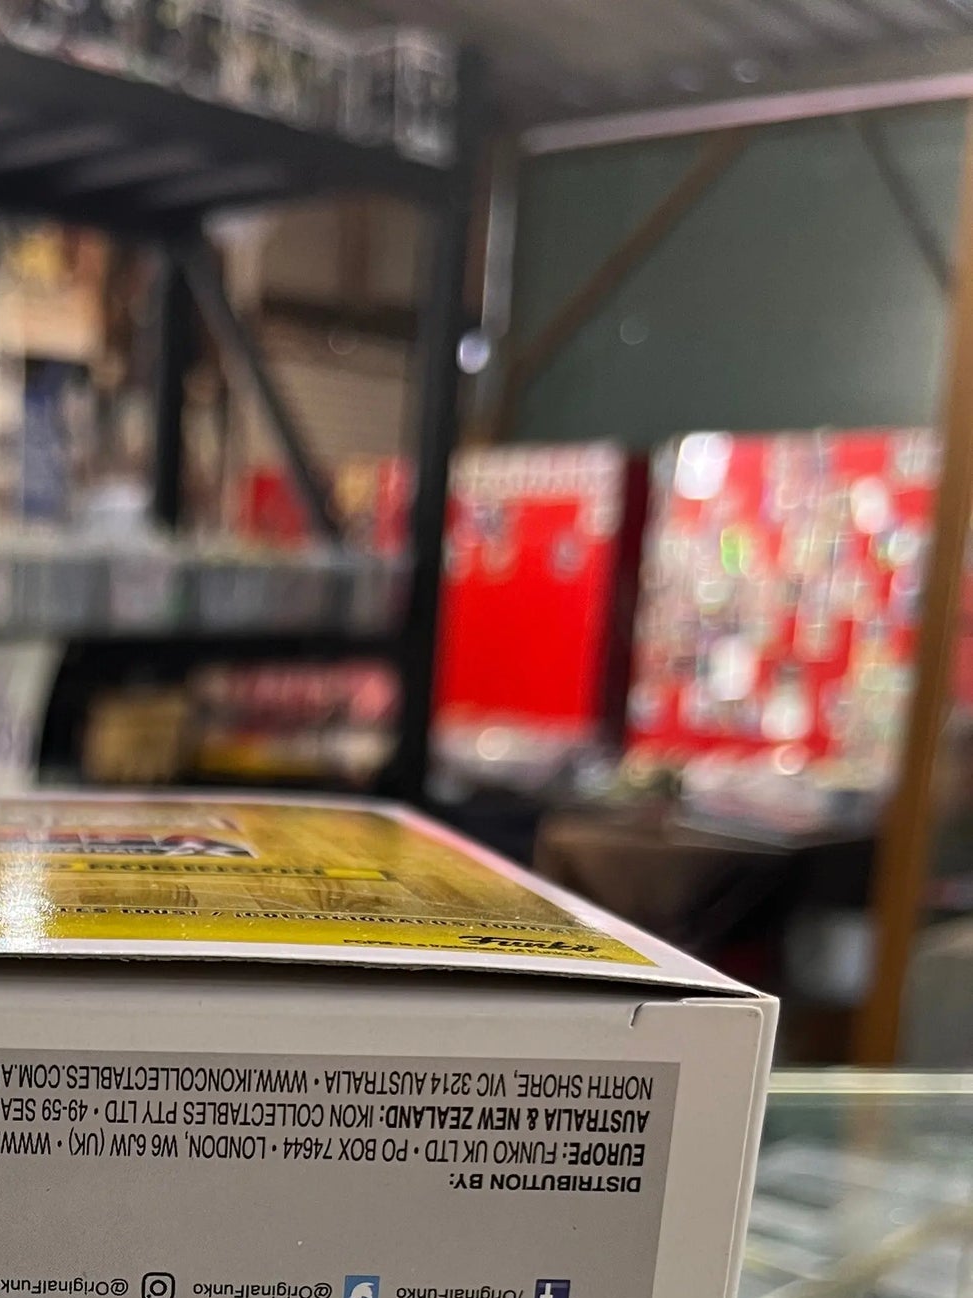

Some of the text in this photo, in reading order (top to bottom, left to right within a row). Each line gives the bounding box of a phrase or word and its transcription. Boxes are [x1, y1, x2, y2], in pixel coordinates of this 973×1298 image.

[323, 1069, 427, 1096] AUSTRALIA
[430, 1071, 472, 1095] 3214
[475, 1072, 506, 1097] VIC
[513, 1069, 583, 1099] SHORE,
[586, 1075, 653, 1100] NORTH
[41, 1097, 88, 1122] 49-59
[104, 1099, 137, 1124] LTD
[140, 1099, 177, 1124] PTY
[182, 1100, 324, 1127] COLLECTABLES
[328, 1103, 374, 1128] IKON
[378, 1104, 474, 1129] ZEALAND:
[476, 1106, 521, 1130] NEW
[525, 1107, 539, 1131] &
[543, 1107, 650, 1132] AUSTRALIA
[67, 1129, 105, 1157] (UK)
[108, 1132, 146, 1157] 6JW
[150, 1133, 178, 1158] W6
[184, 1131, 266, 1160] LONDON,
[282, 1136, 333, 1160] 74644
[337, 1137, 377, 1161] BOX
[381, 1137, 408, 1162] PO
[424, 1138, 458, 1162] LTD
[461, 1139, 488, 1163] UK
[492, 1139, 557, 1164] FUNKO
[561, 1141, 646, 1167] EUROPE:
[448, 1172, 641, 1193] DISTRIBUTION BY:
